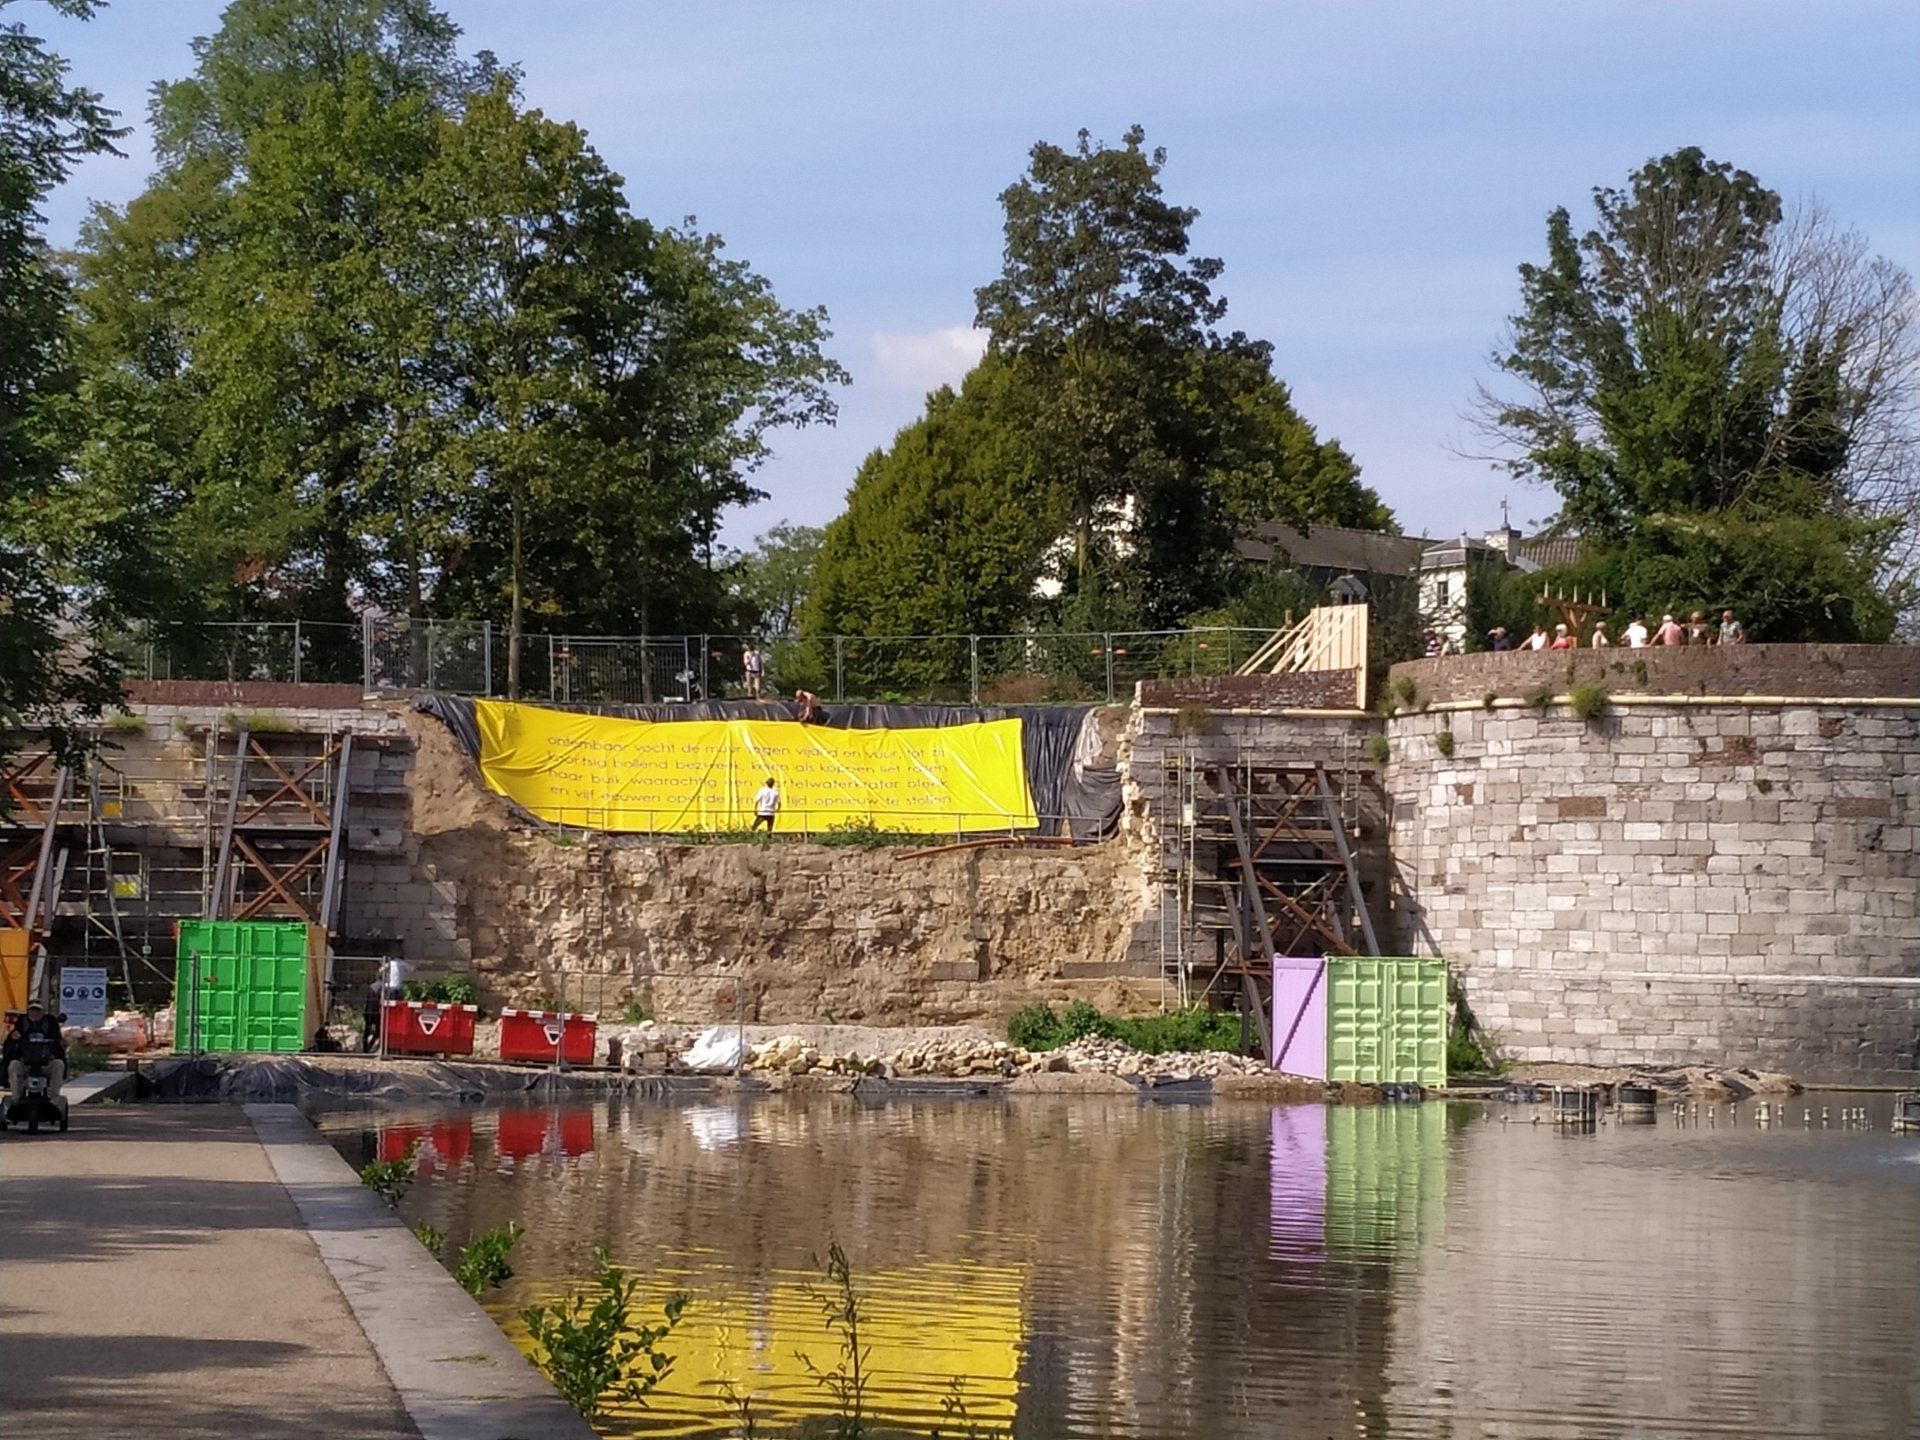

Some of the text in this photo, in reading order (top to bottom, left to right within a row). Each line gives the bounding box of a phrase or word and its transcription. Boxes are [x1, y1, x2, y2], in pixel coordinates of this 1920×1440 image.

[635, 743, 675, 754] vocht
[681, 744, 700, 754] de
[748, 746, 790, 756] egen
[795, 762, 815, 772] als
[880, 765, 900, 773] liet
[907, 765, 948, 773] rolen
[548, 768, 582, 781] haar
[550, 786, 569, 795] en
[574, 788, 594, 801] vijf
[601, 792, 661, 802] eeuwen
[786, 795, 807, 807] tijd
[886, 797, 900, 806] te
